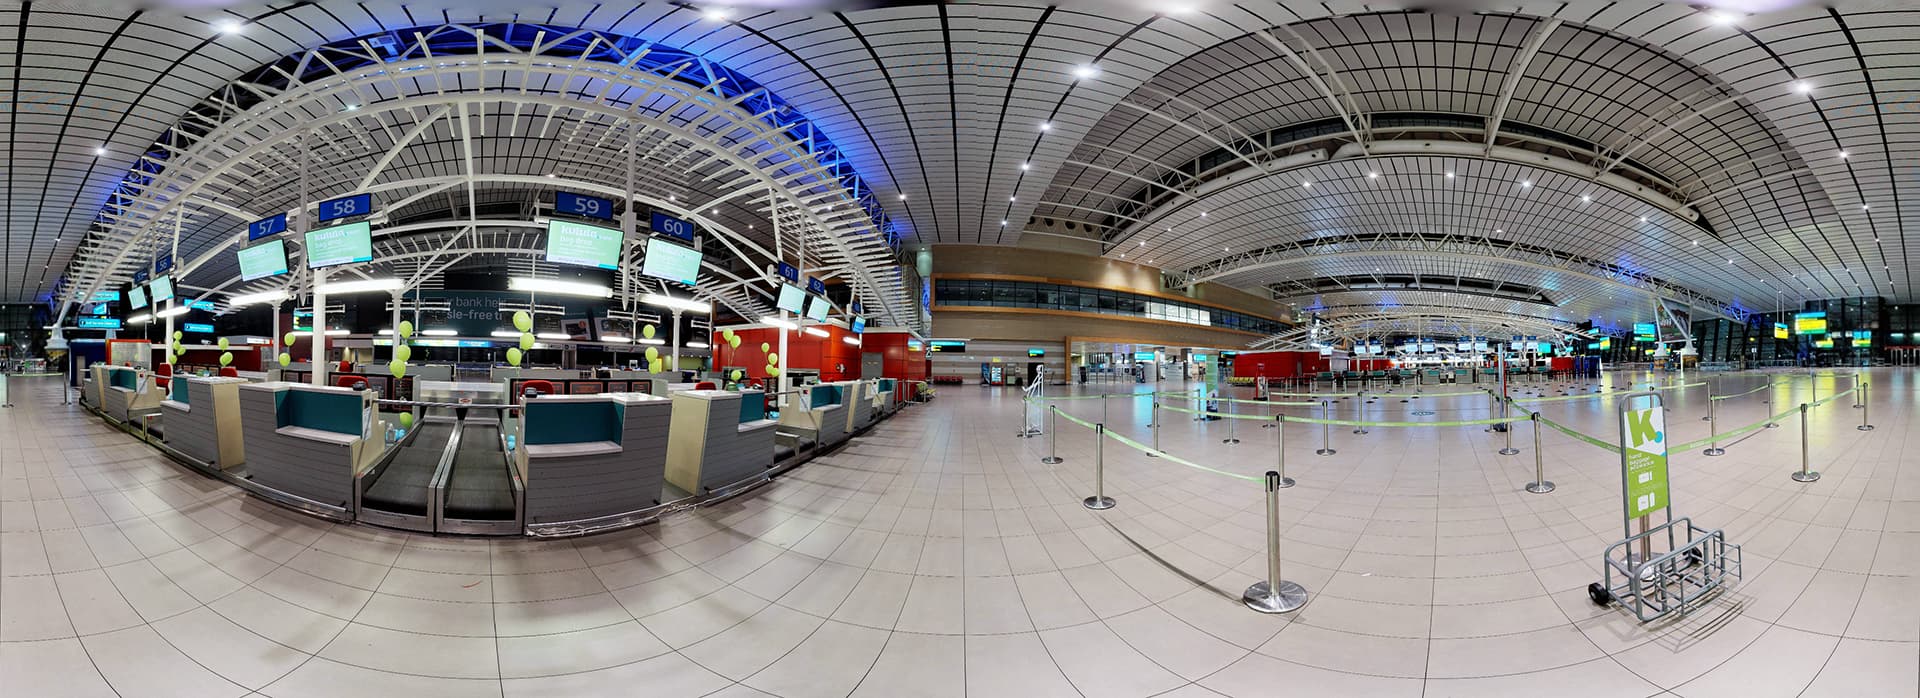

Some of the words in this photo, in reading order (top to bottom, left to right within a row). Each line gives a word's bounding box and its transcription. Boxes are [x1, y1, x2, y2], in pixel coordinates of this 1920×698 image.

[333, 199, 355, 216] 58
[575, 197, 599, 214] 59
[259, 218, 274, 235] 57
[663, 219, 683, 235] 60
[785, 267, 794, 278] 61
[814, 281, 821, 291] 62
[456, 297, 482, 308] bank
[447, 309, 492, 320] sle-free
